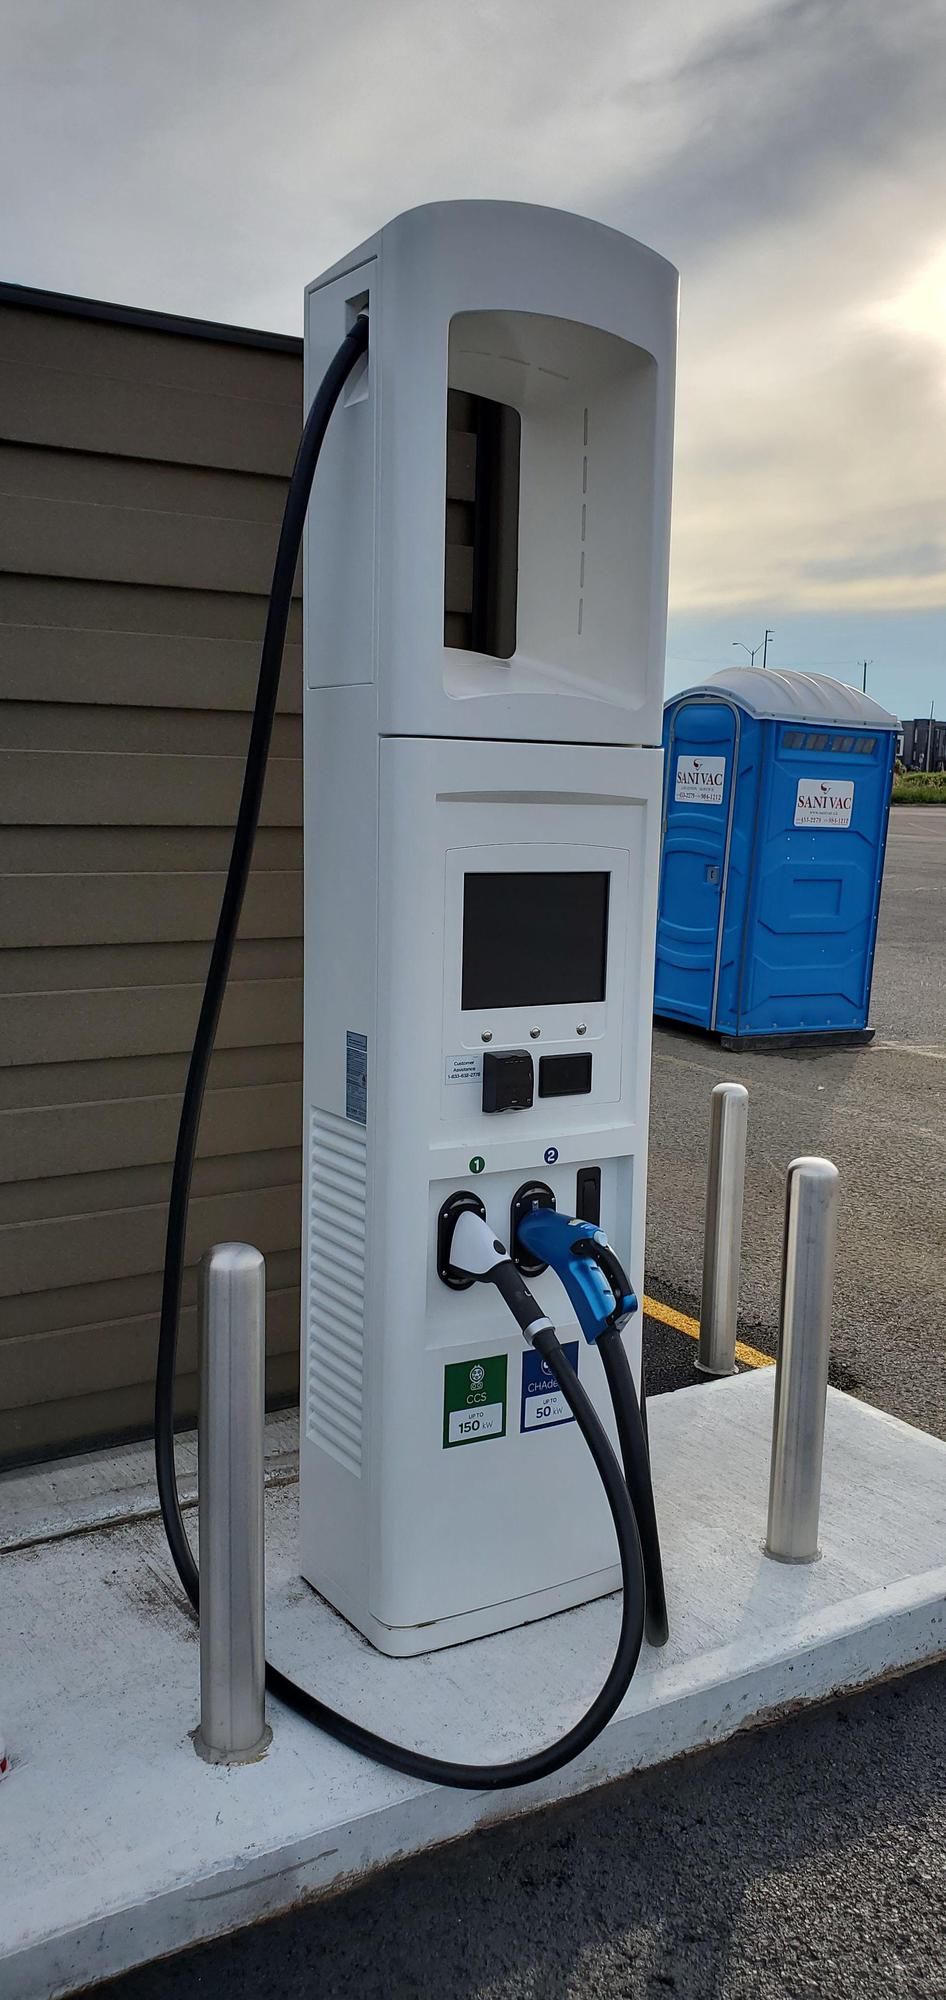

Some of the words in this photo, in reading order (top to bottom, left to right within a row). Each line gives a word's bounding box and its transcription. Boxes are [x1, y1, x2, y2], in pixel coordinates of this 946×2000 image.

[547, 1150, 555, 1161] 2
[474, 1160, 479, 1171] 1
[528, 1380, 559, 1392] CHAde
[466, 1392, 487, 1404] CCS
[536, 1406, 551, 1419] 50
[459, 1420, 480, 1434] 150
